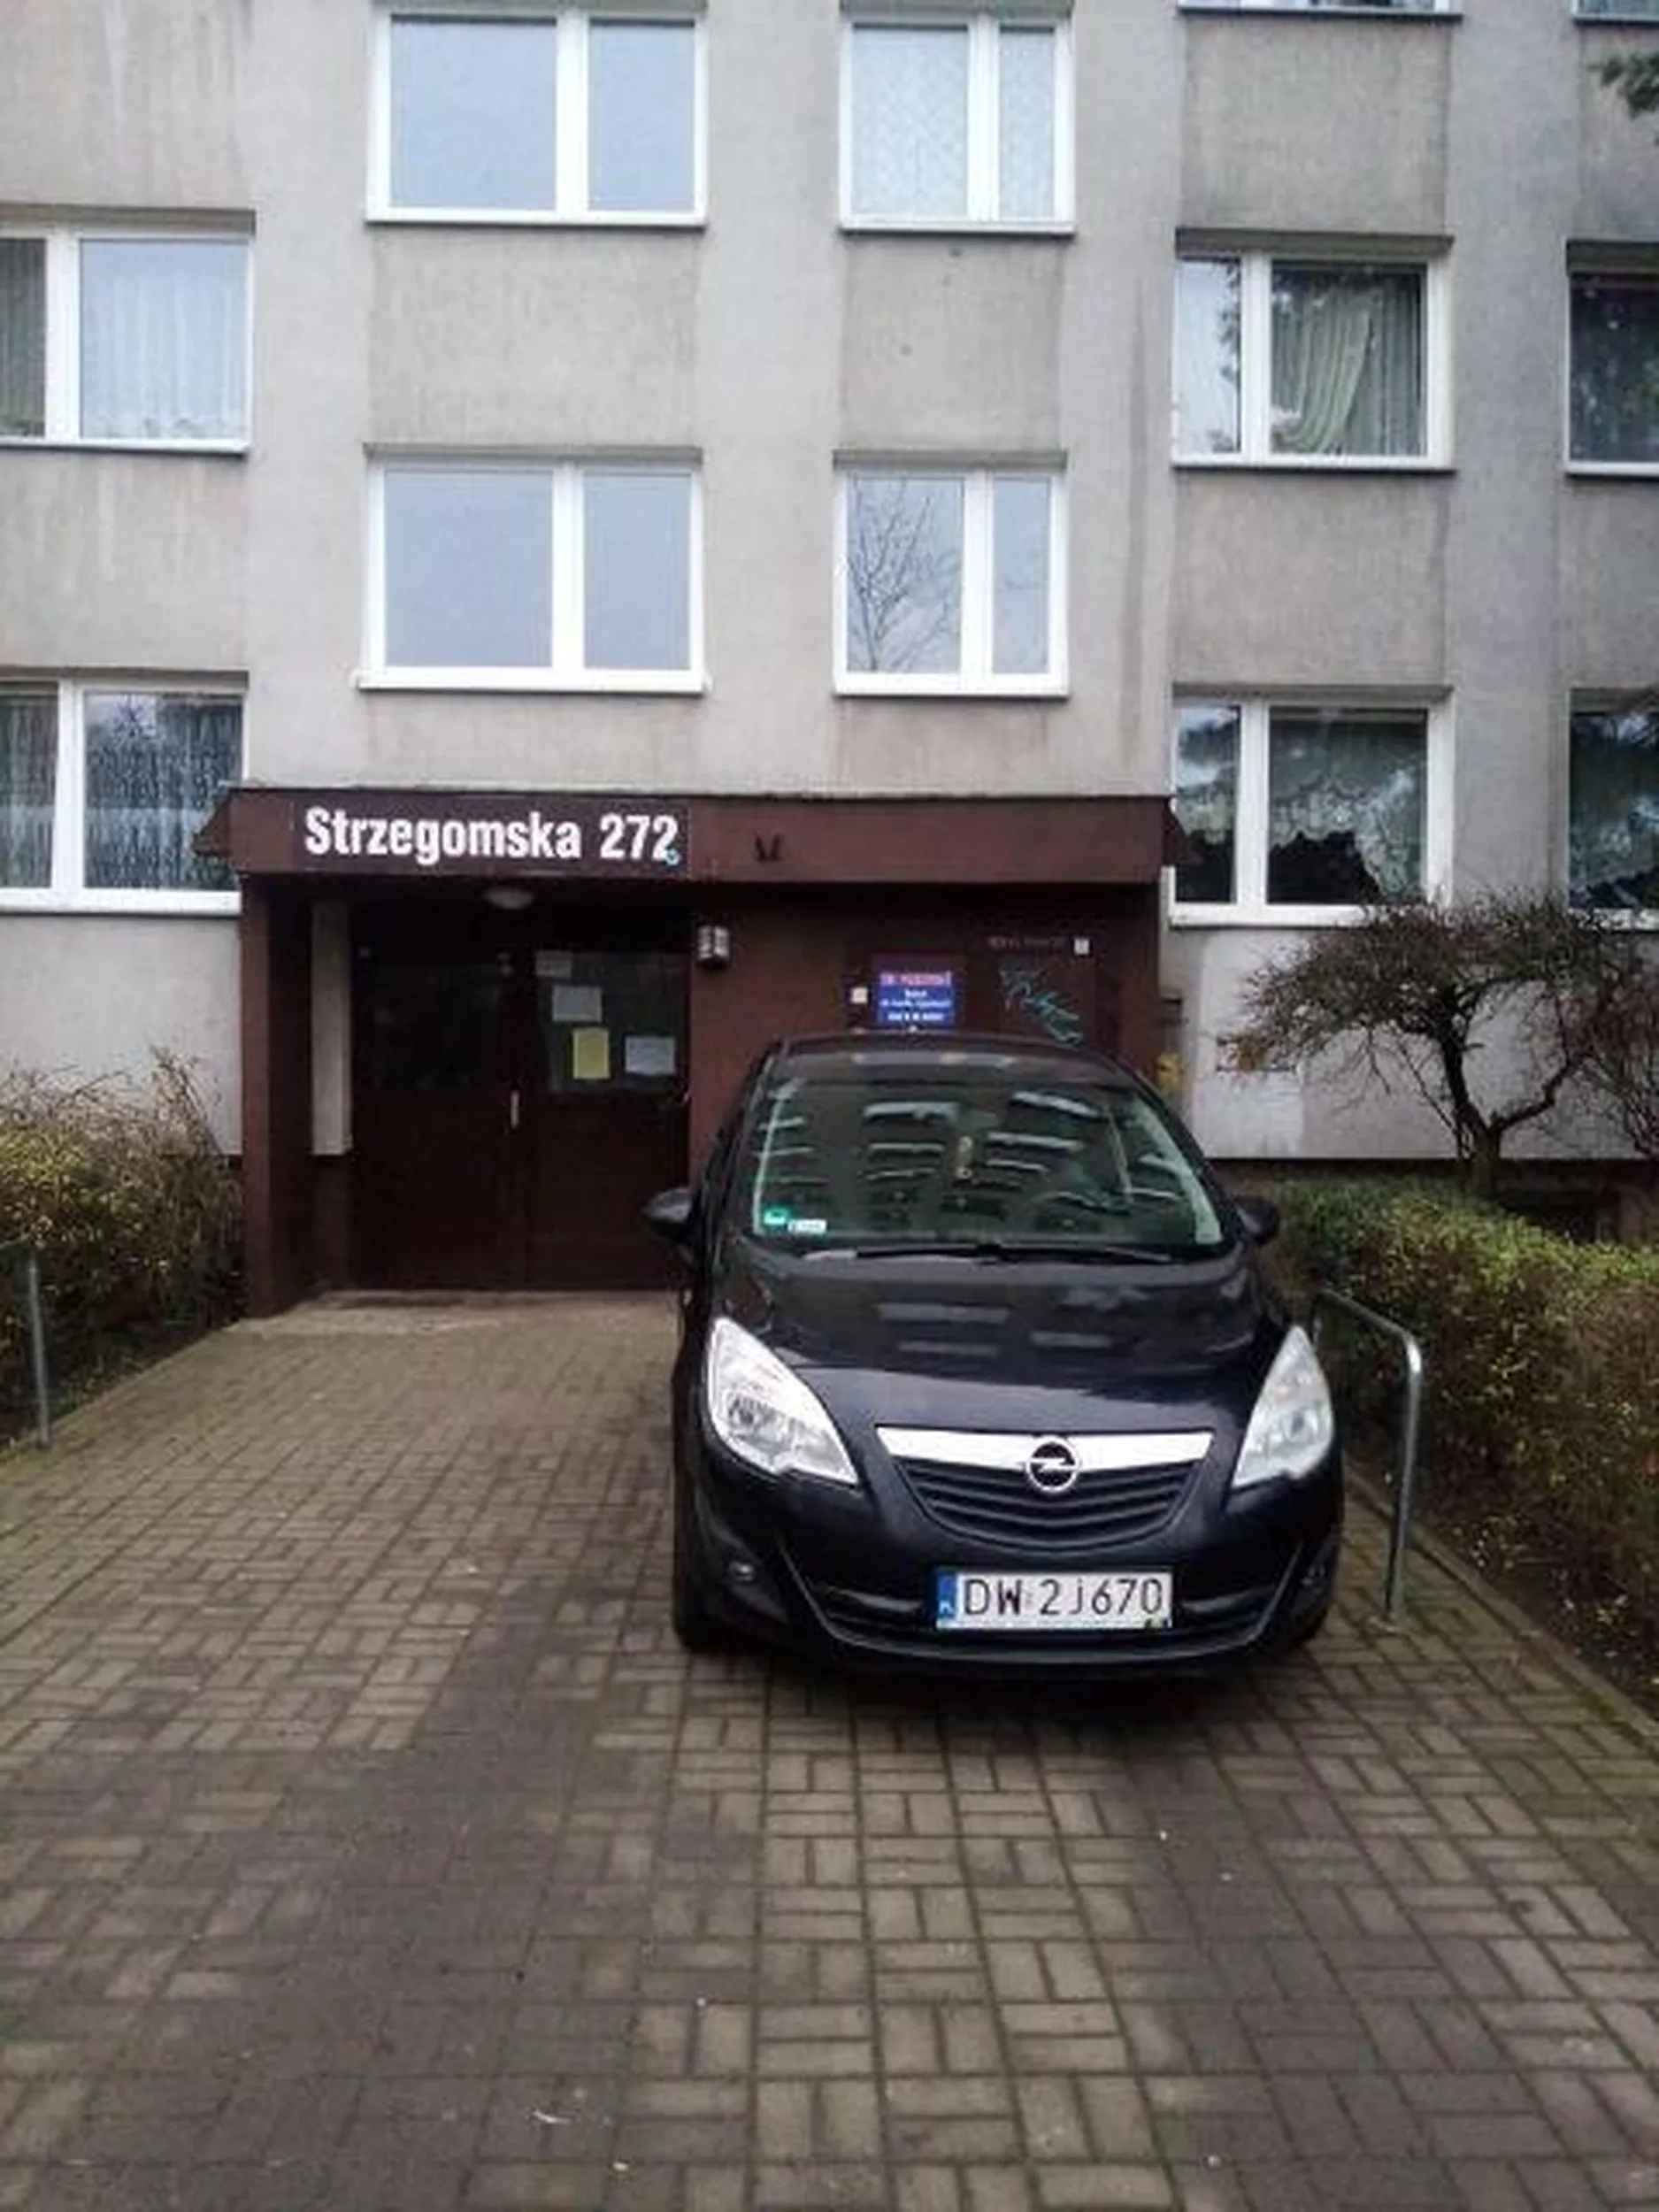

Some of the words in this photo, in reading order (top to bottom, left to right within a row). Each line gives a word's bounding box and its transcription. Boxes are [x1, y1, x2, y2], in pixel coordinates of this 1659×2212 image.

[304, 806, 581, 865] Strzegomska
[599, 812, 679, 860] 272
[964, 1578, 1022, 1616] DW
[1039, 1578, 1164, 1616] 2J670
